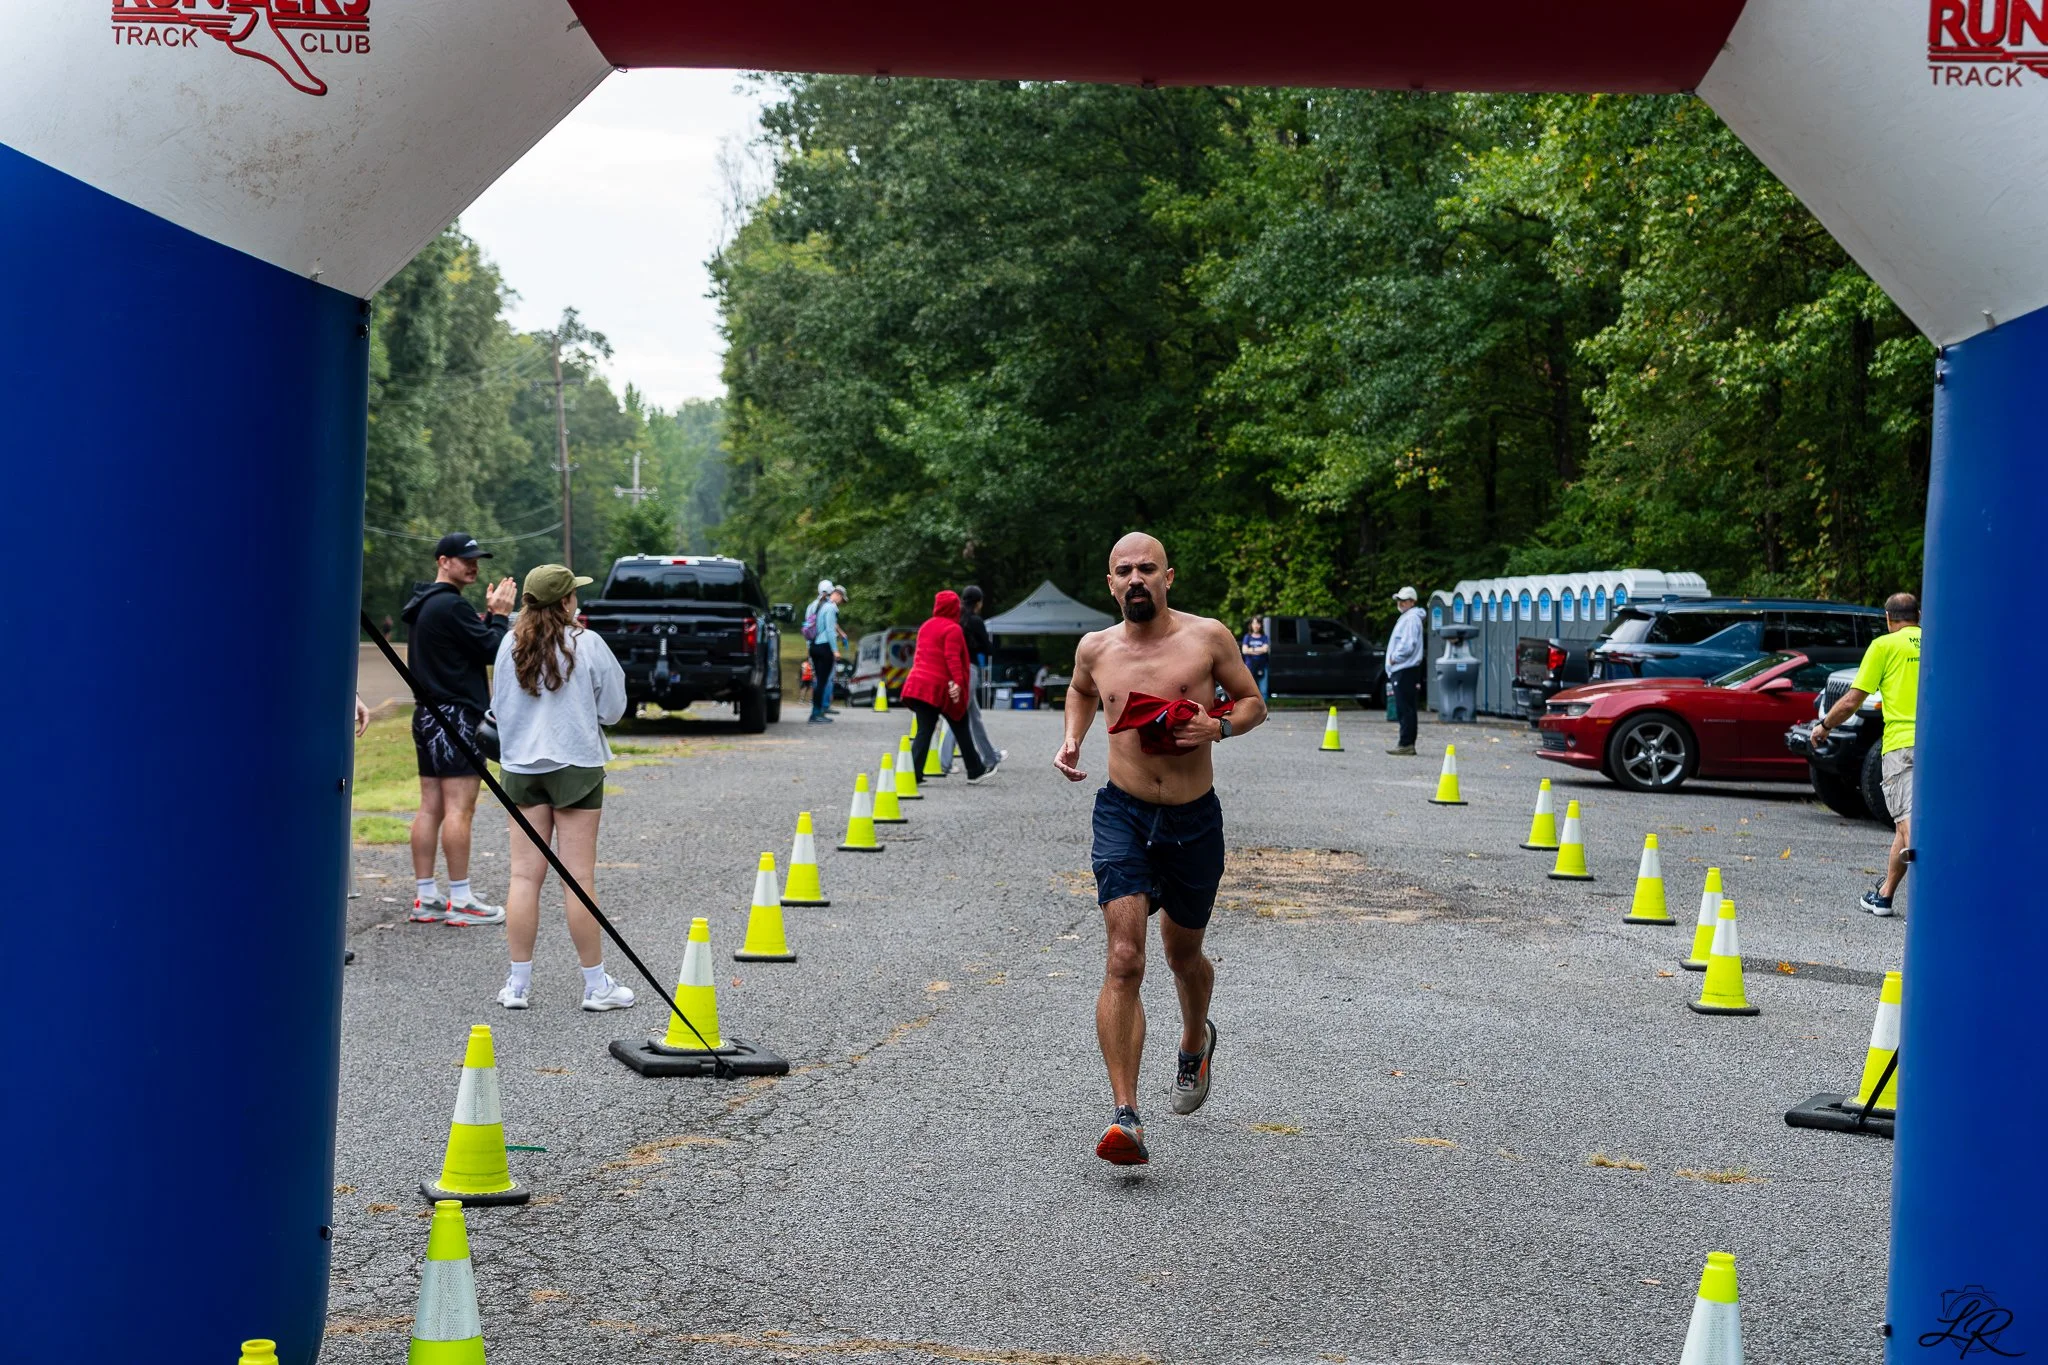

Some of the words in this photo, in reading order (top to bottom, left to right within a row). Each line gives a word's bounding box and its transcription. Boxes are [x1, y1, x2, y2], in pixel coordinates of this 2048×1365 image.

[111, 25, 199, 48] TRACK
[300, 32, 371, 54] CLUB
[1928, 65, 2023, 87] TRACK
